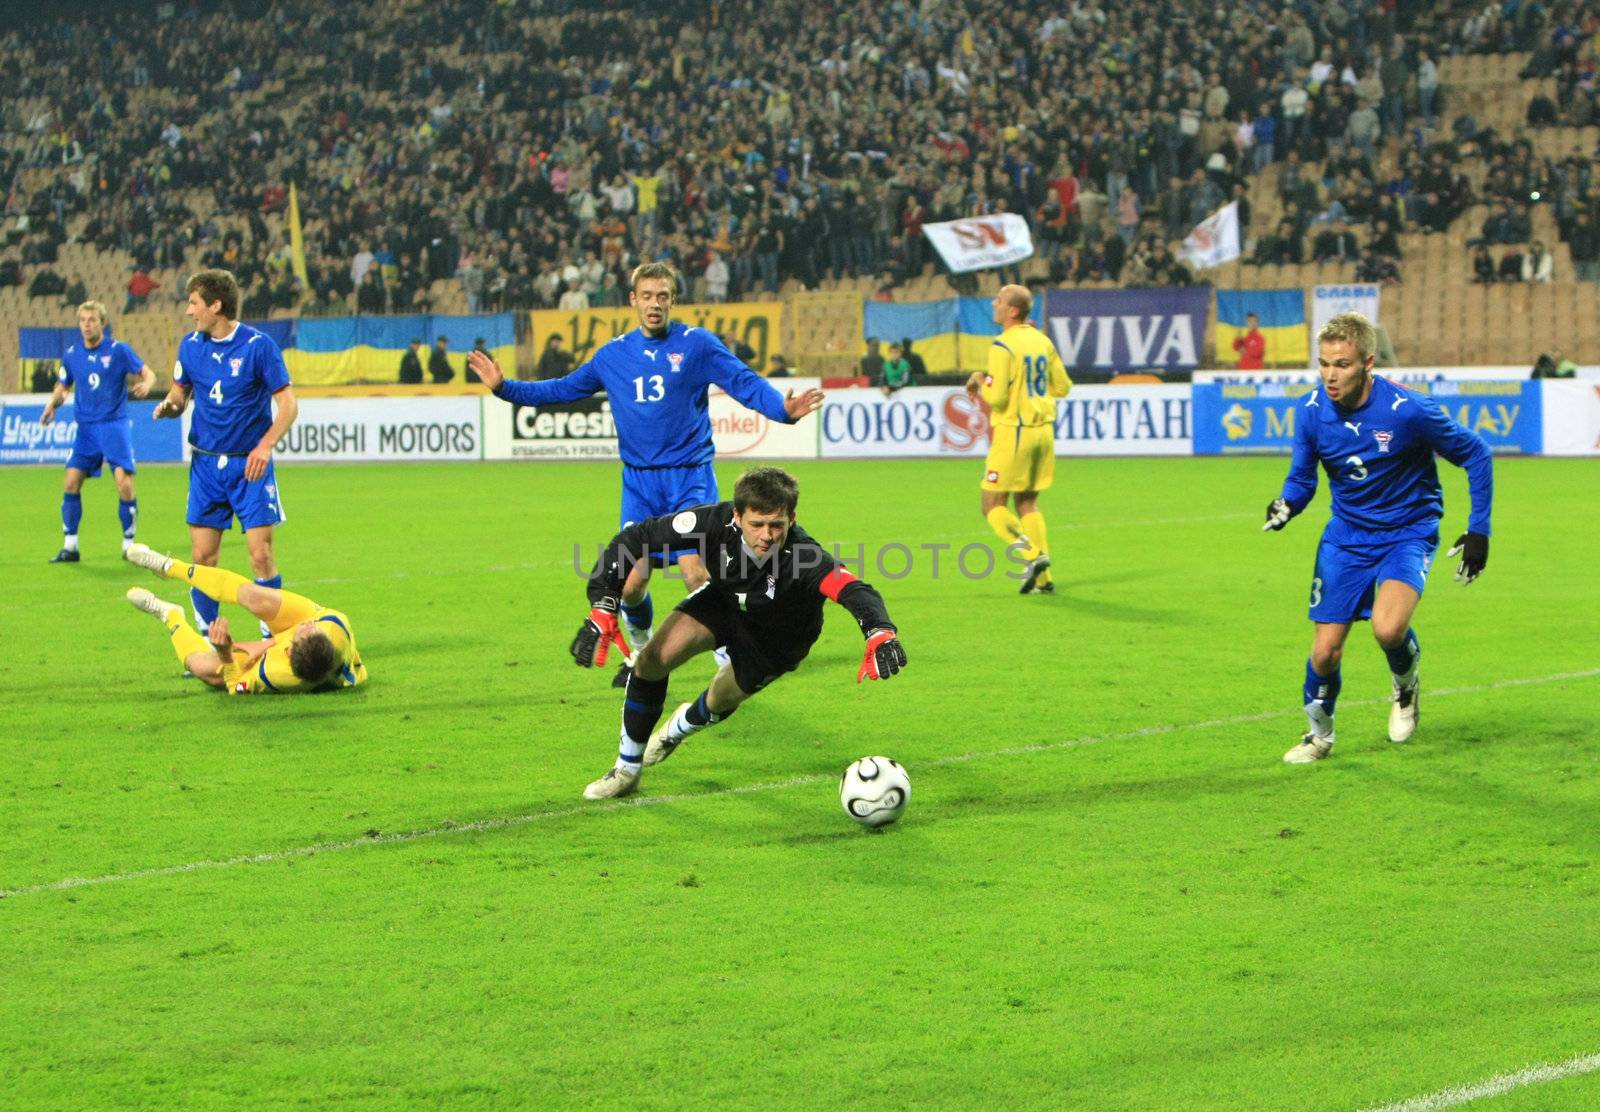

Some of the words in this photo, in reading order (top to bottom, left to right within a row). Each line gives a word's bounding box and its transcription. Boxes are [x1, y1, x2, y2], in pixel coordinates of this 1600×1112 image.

[1049, 314, 1199, 367] VIVA
[88, 372, 101, 391] 9
[632, 375, 666, 403] 13
[1023, 355, 1049, 397] 18
[208, 379, 224, 405] 4
[823, 401, 935, 443] СОЮЗ
[379, 423, 475, 453] MOTORS
[1346, 456, 1368, 480] 3
[1309, 577, 1323, 608] 3
